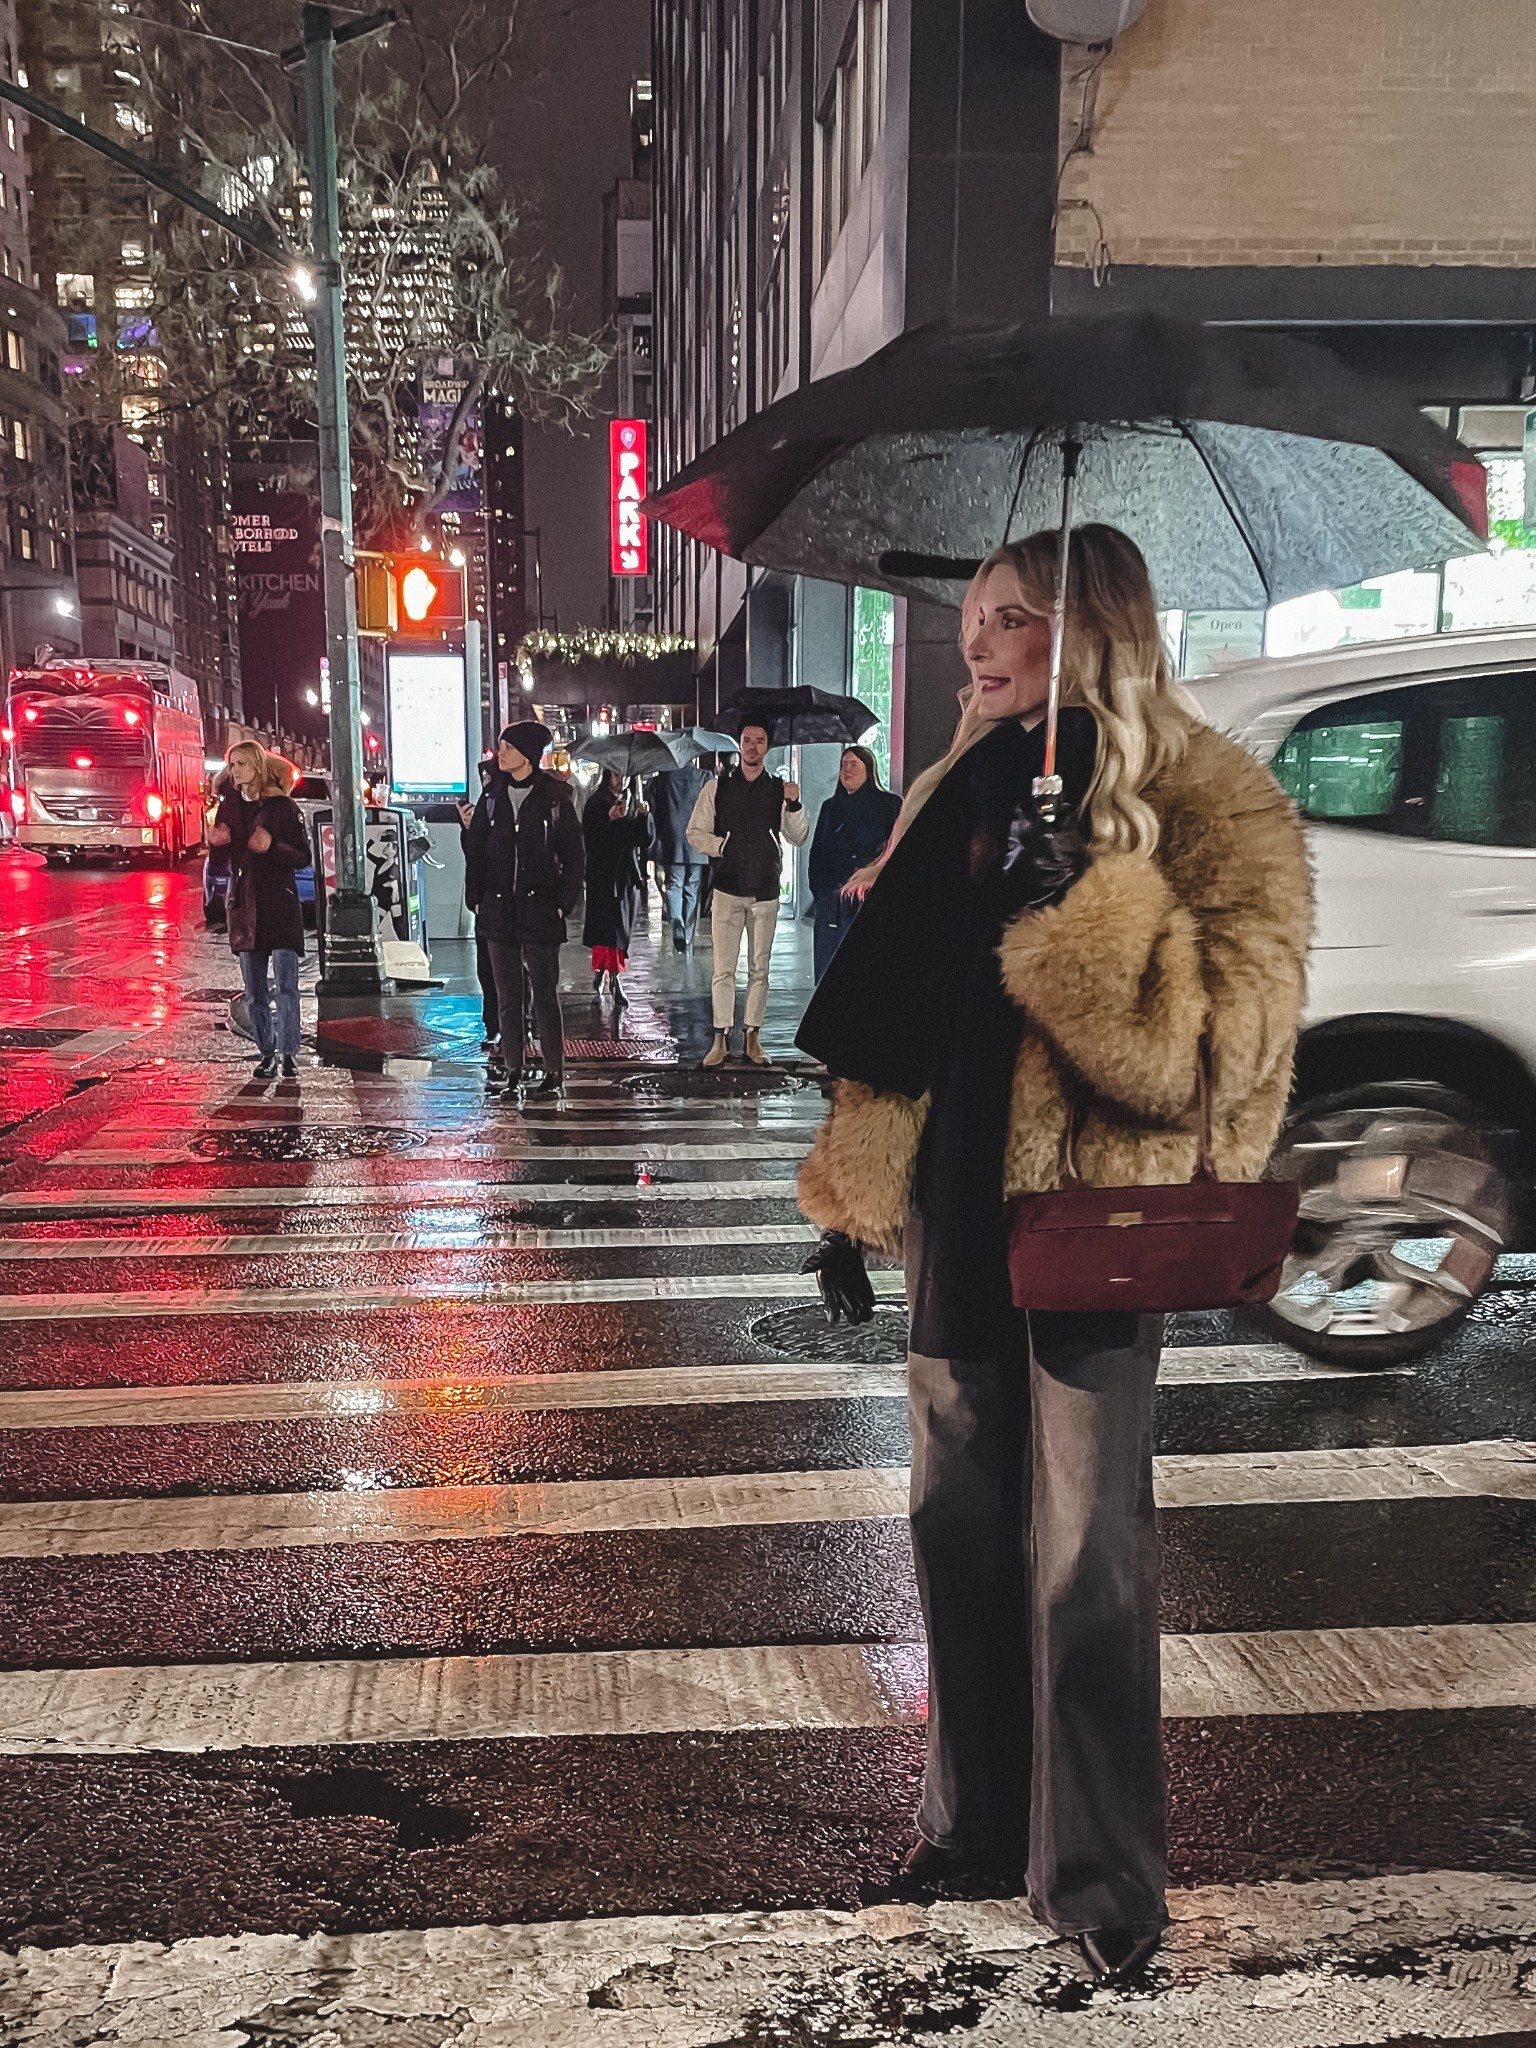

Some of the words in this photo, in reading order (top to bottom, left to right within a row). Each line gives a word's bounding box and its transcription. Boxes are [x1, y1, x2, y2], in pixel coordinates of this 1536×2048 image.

[423, 389, 462, 404] MAGI
[618, 452, 641, 547] PARK
[232, 515, 270, 526] OMER
[235, 528, 298, 540] BORHOOD
[233, 541, 272, 552] OTELS
[238, 573, 319, 592] KITCHEN
[1210, 619, 1243, 632] Open
